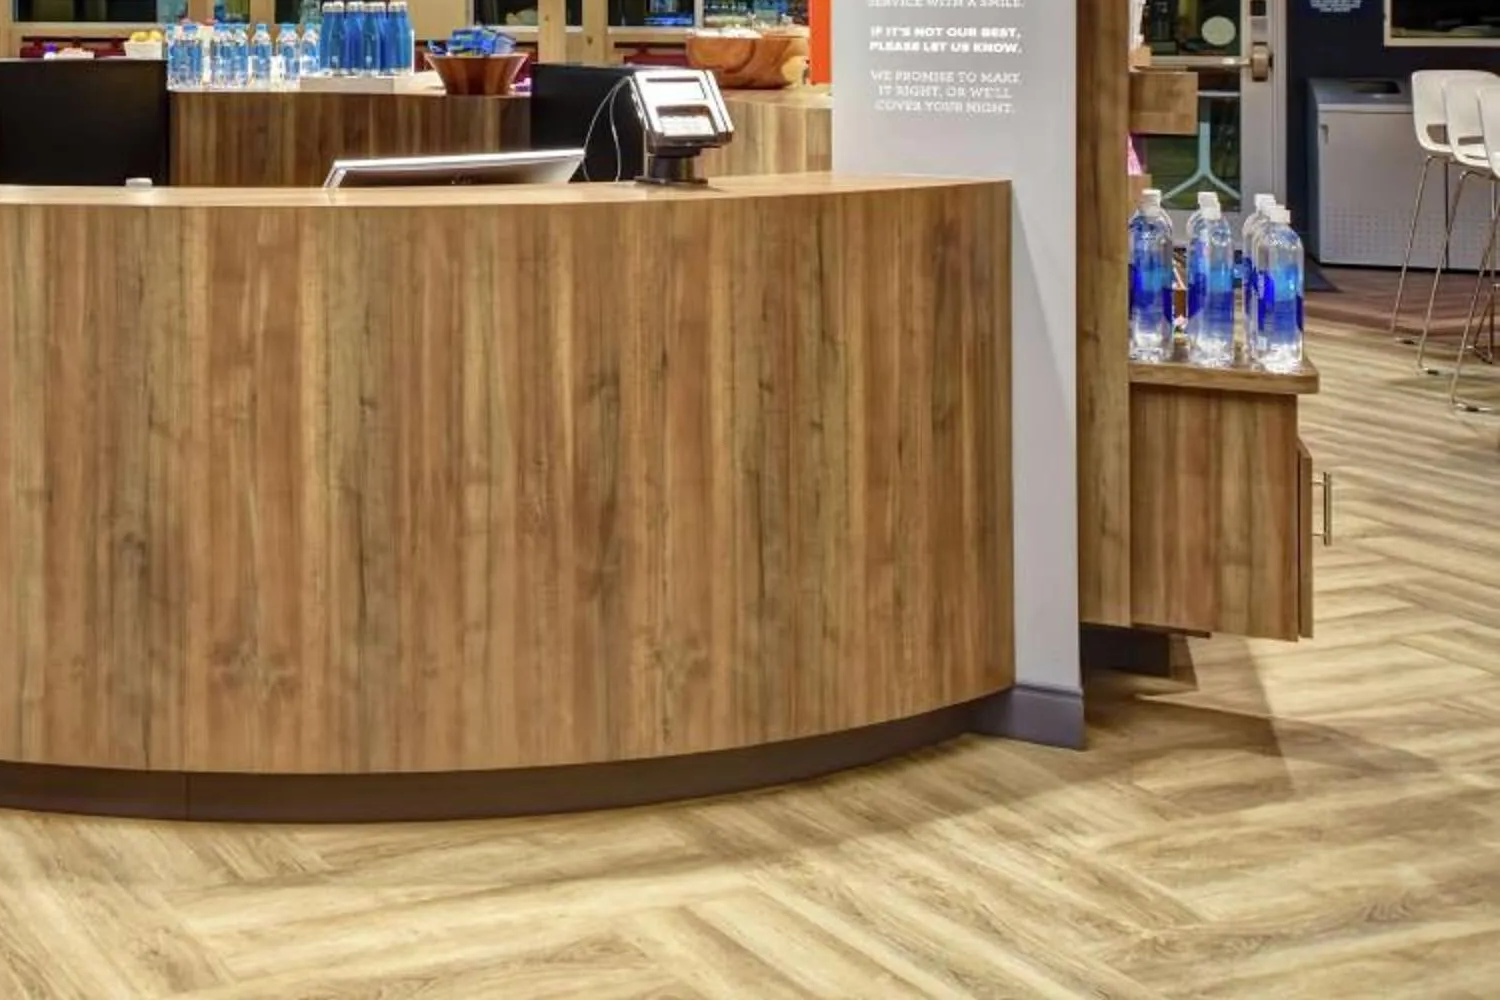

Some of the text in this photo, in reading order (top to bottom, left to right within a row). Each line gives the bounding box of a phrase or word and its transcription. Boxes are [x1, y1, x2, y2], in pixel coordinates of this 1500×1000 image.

[870, 26, 883, 37] IF
[913, 26, 945, 37] NOT
[946, 26, 977, 37] OUR
[869, 41, 920, 51] PLEASE
[923, 41, 948, 52] LET
[950, 42, 970, 53] US
[870, 70, 892, 81] WE
[957, 71, 977, 83] TO
[878, 85, 892, 96] IT
[946, 86, 966, 97] OR
[925, 101, 963, 112] YOUR
